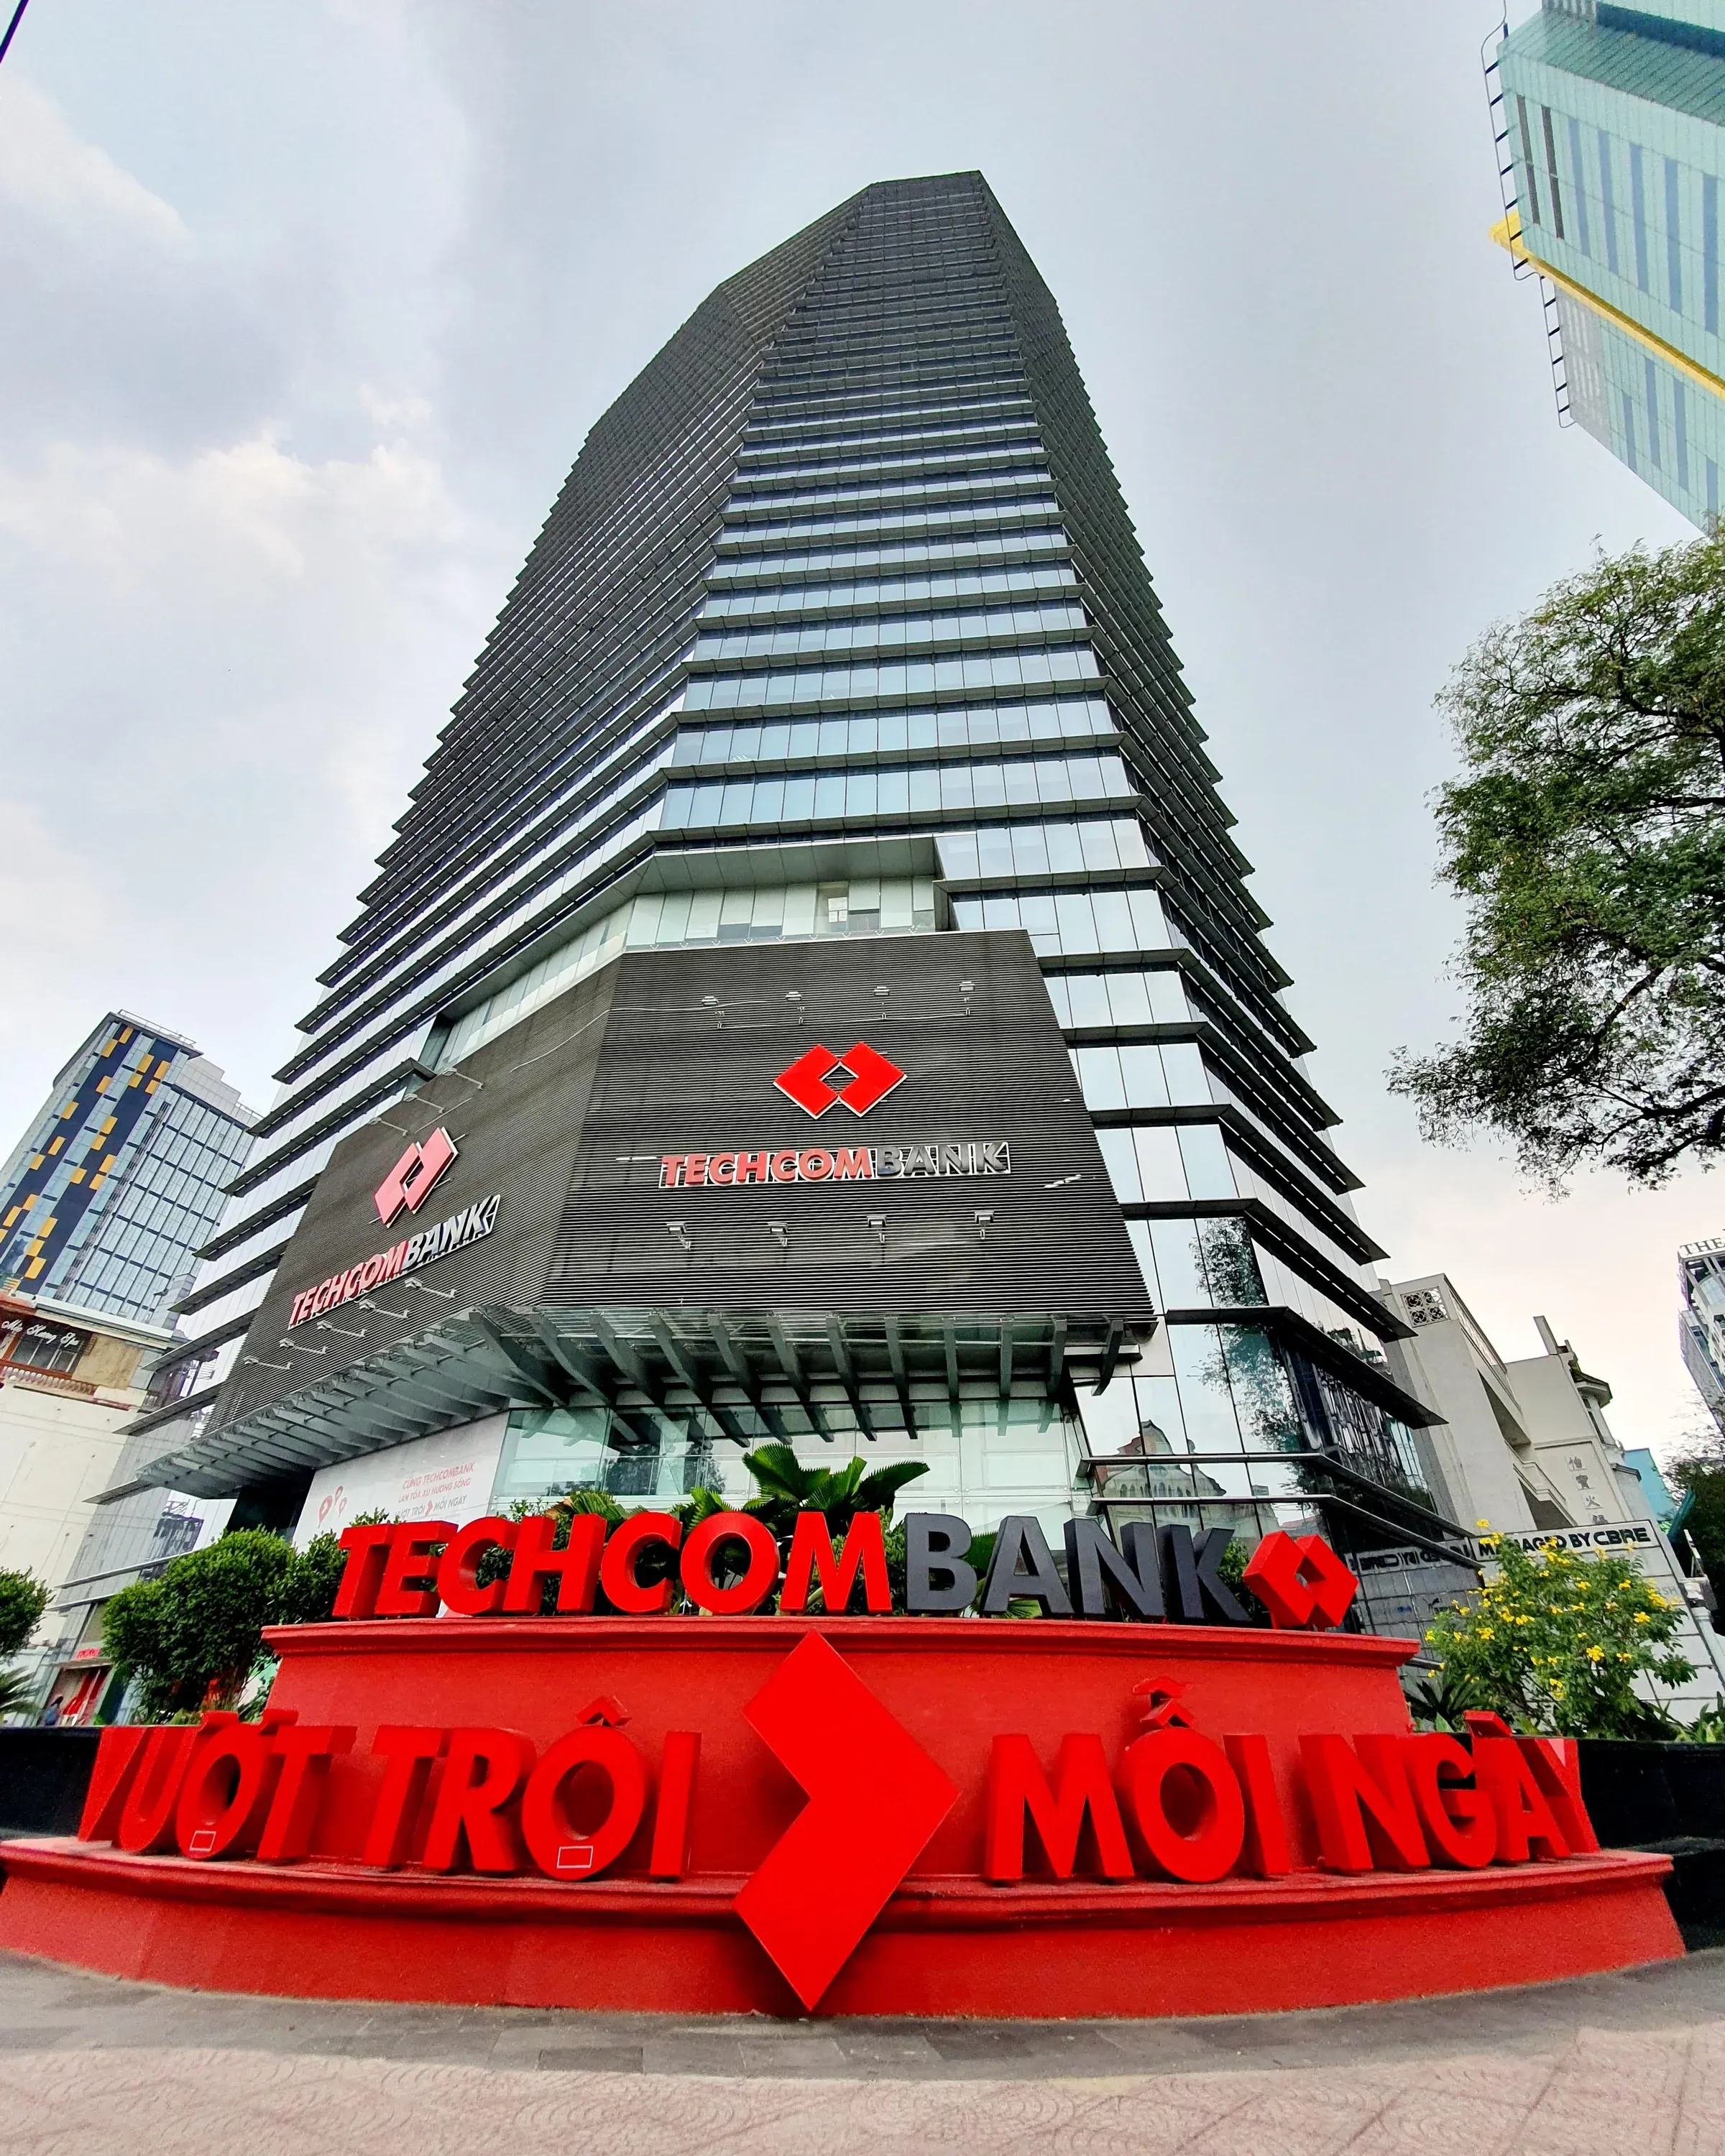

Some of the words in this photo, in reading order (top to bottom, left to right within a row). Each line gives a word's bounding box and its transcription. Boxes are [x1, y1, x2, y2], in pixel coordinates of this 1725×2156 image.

[660, 1141, 1011, 1187] TECHCOMBANK
[289, 1195, 500, 1328] TECHCOMBANK
[1679, 1237, 1723, 1256] THE
[423, 1462, 475, 1485] TECHCOMBANK
[1568, 1531, 1591, 1549] BY
[1593, 1526, 1652, 1547] CBRE
[331, 1511, 1255, 1624] TECHCOMBANK
[985, 1674, 1294, 1884] MỖI
[1297, 1710, 1601, 1877] NGÀY
